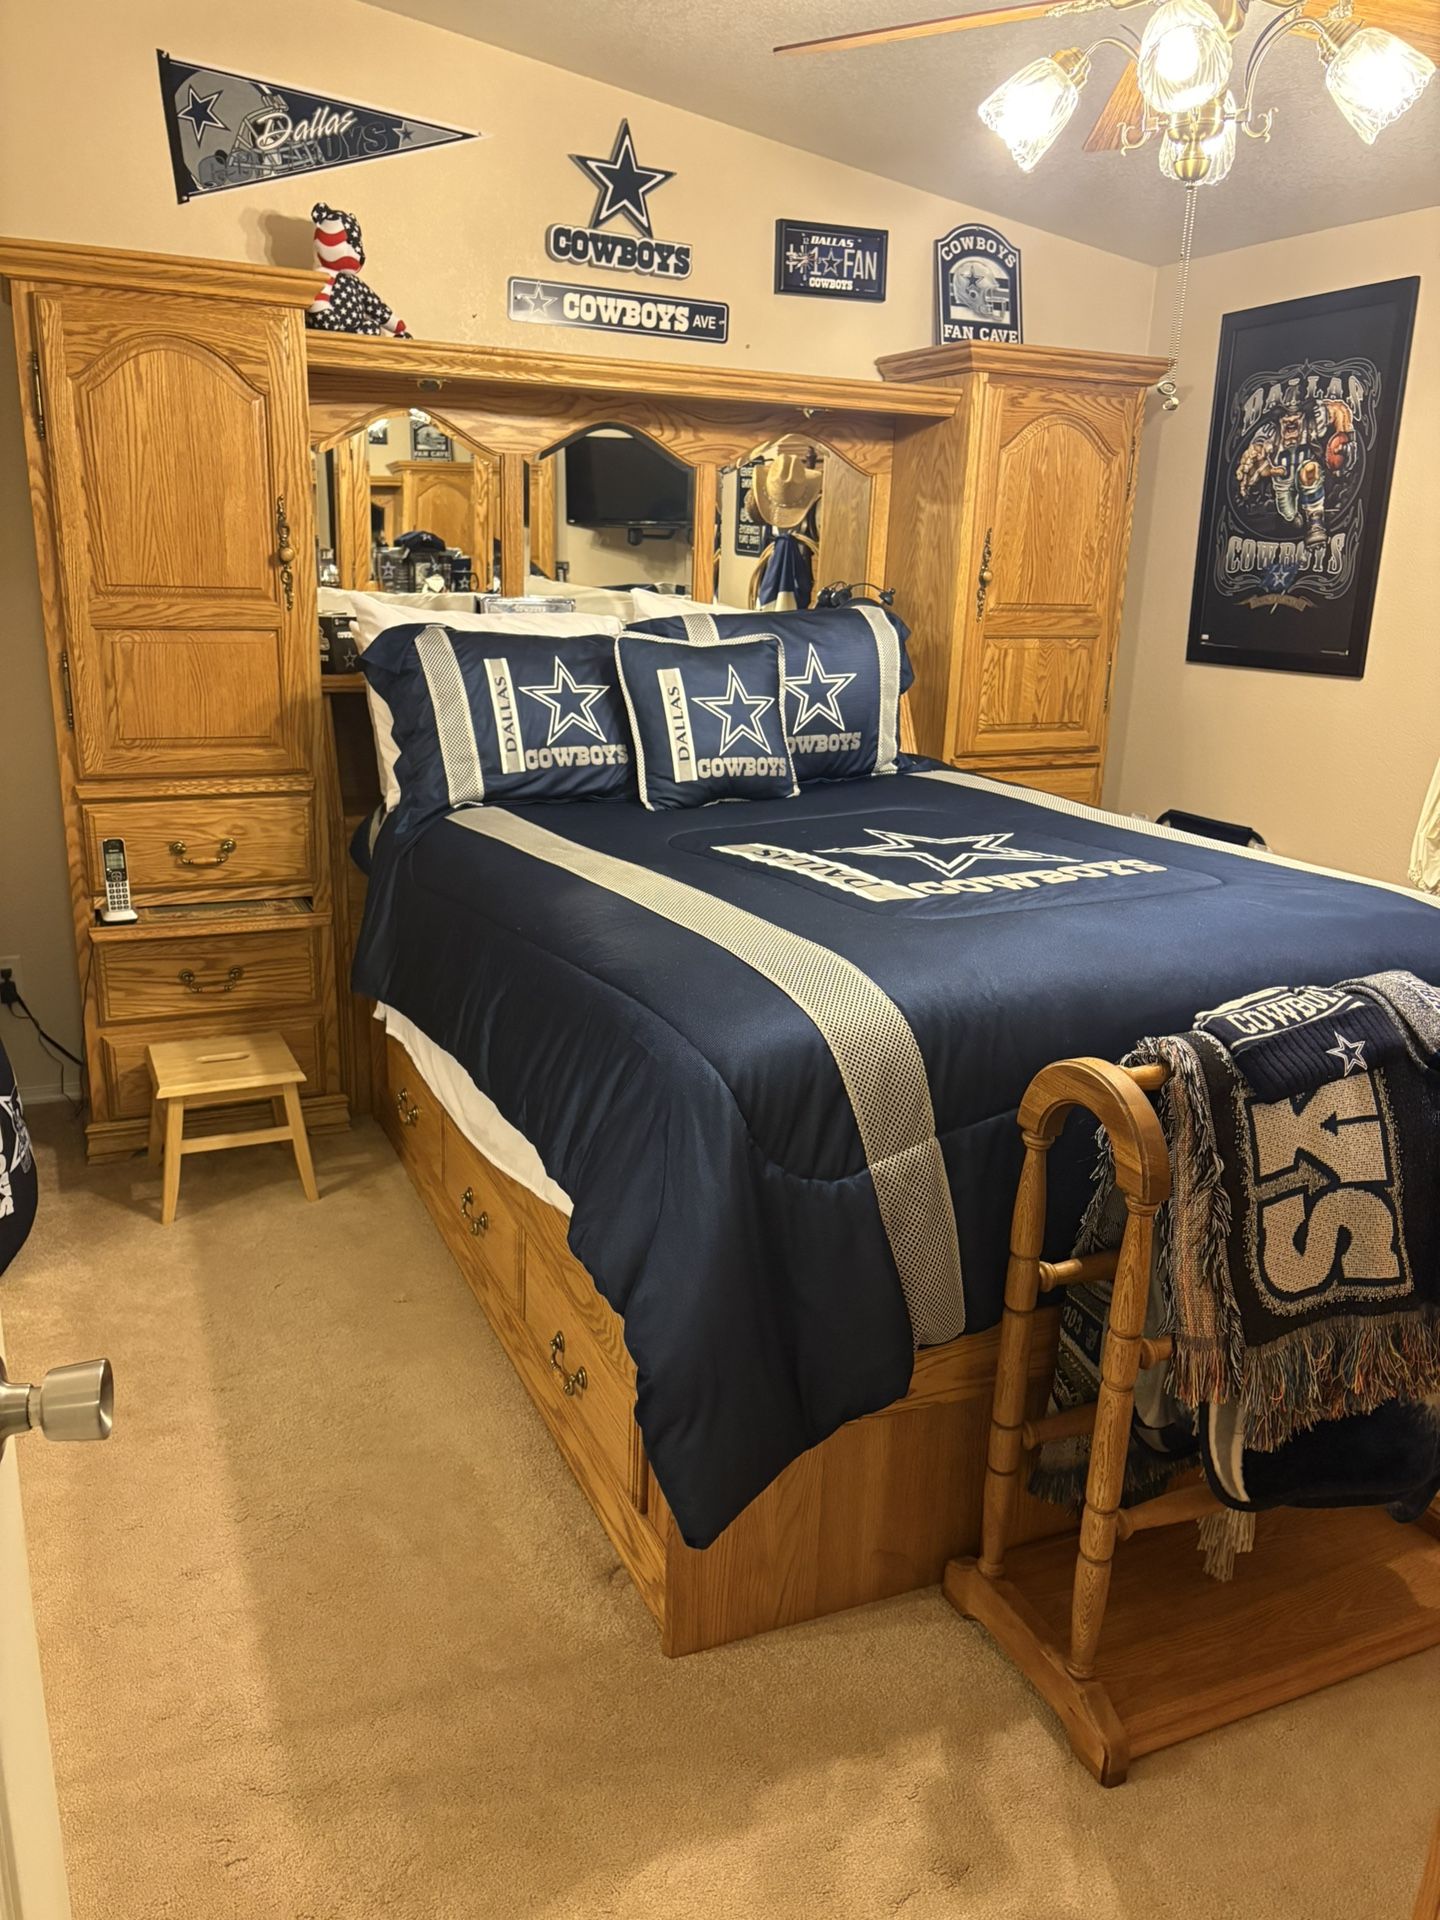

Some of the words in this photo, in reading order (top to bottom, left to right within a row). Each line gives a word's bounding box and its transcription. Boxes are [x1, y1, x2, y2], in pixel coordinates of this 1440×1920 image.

[256, 105, 358, 150] Dallas
[551, 225, 692, 277] COWBOYS
[810, 235, 854, 248] DALLAS
[941, 236, 1016, 268] COWBOYS
[843, 249, 877, 280] FAN
[809, 277, 854, 291] COWBOYS
[563, 292, 690, 333] COWBOYS
[693, 314, 716, 330] AVE
[944, 324, 974, 340] FAN
[979, 327, 1018, 344] CAVE
[494, 676, 517, 753] DALLAS
[667, 685, 691, 762] DALLAS
[525, 744, 629, 770] COWBOYS
[786, 732, 862, 755] OWBOYS
[697, 757, 787, 779] COWBOYS
[753, 849, 882, 889] DALLAS
[908, 859, 1168, 895] COWBOYS
